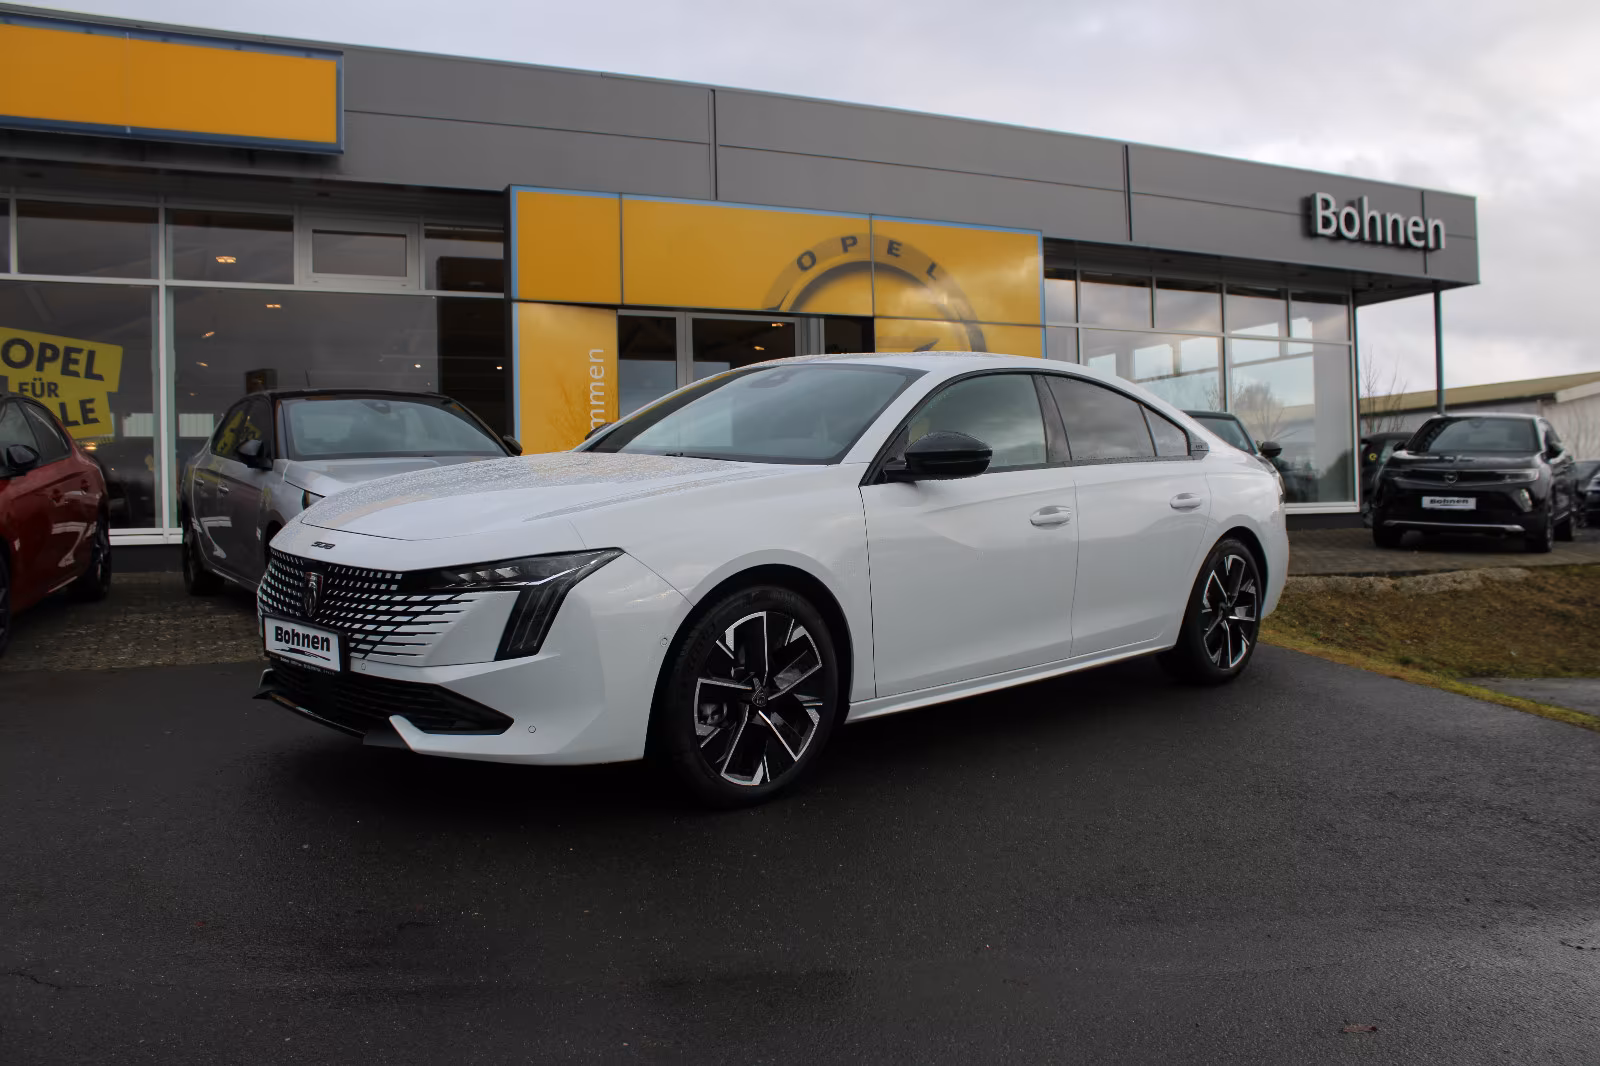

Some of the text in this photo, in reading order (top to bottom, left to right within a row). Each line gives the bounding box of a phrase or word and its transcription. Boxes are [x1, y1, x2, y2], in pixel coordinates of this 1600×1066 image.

[1313, 192, 1446, 249] Bohnen
[796, 235, 937, 280] OPEL
[1, 338, 104, 381] OPEL
[18, 377, 60, 398] FÜR
[589, 348, 605, 431] mmen
[59, 398, 101, 427] LE
[311, 541, 336, 549] 508
[274, 626, 331, 652] Bohnen
